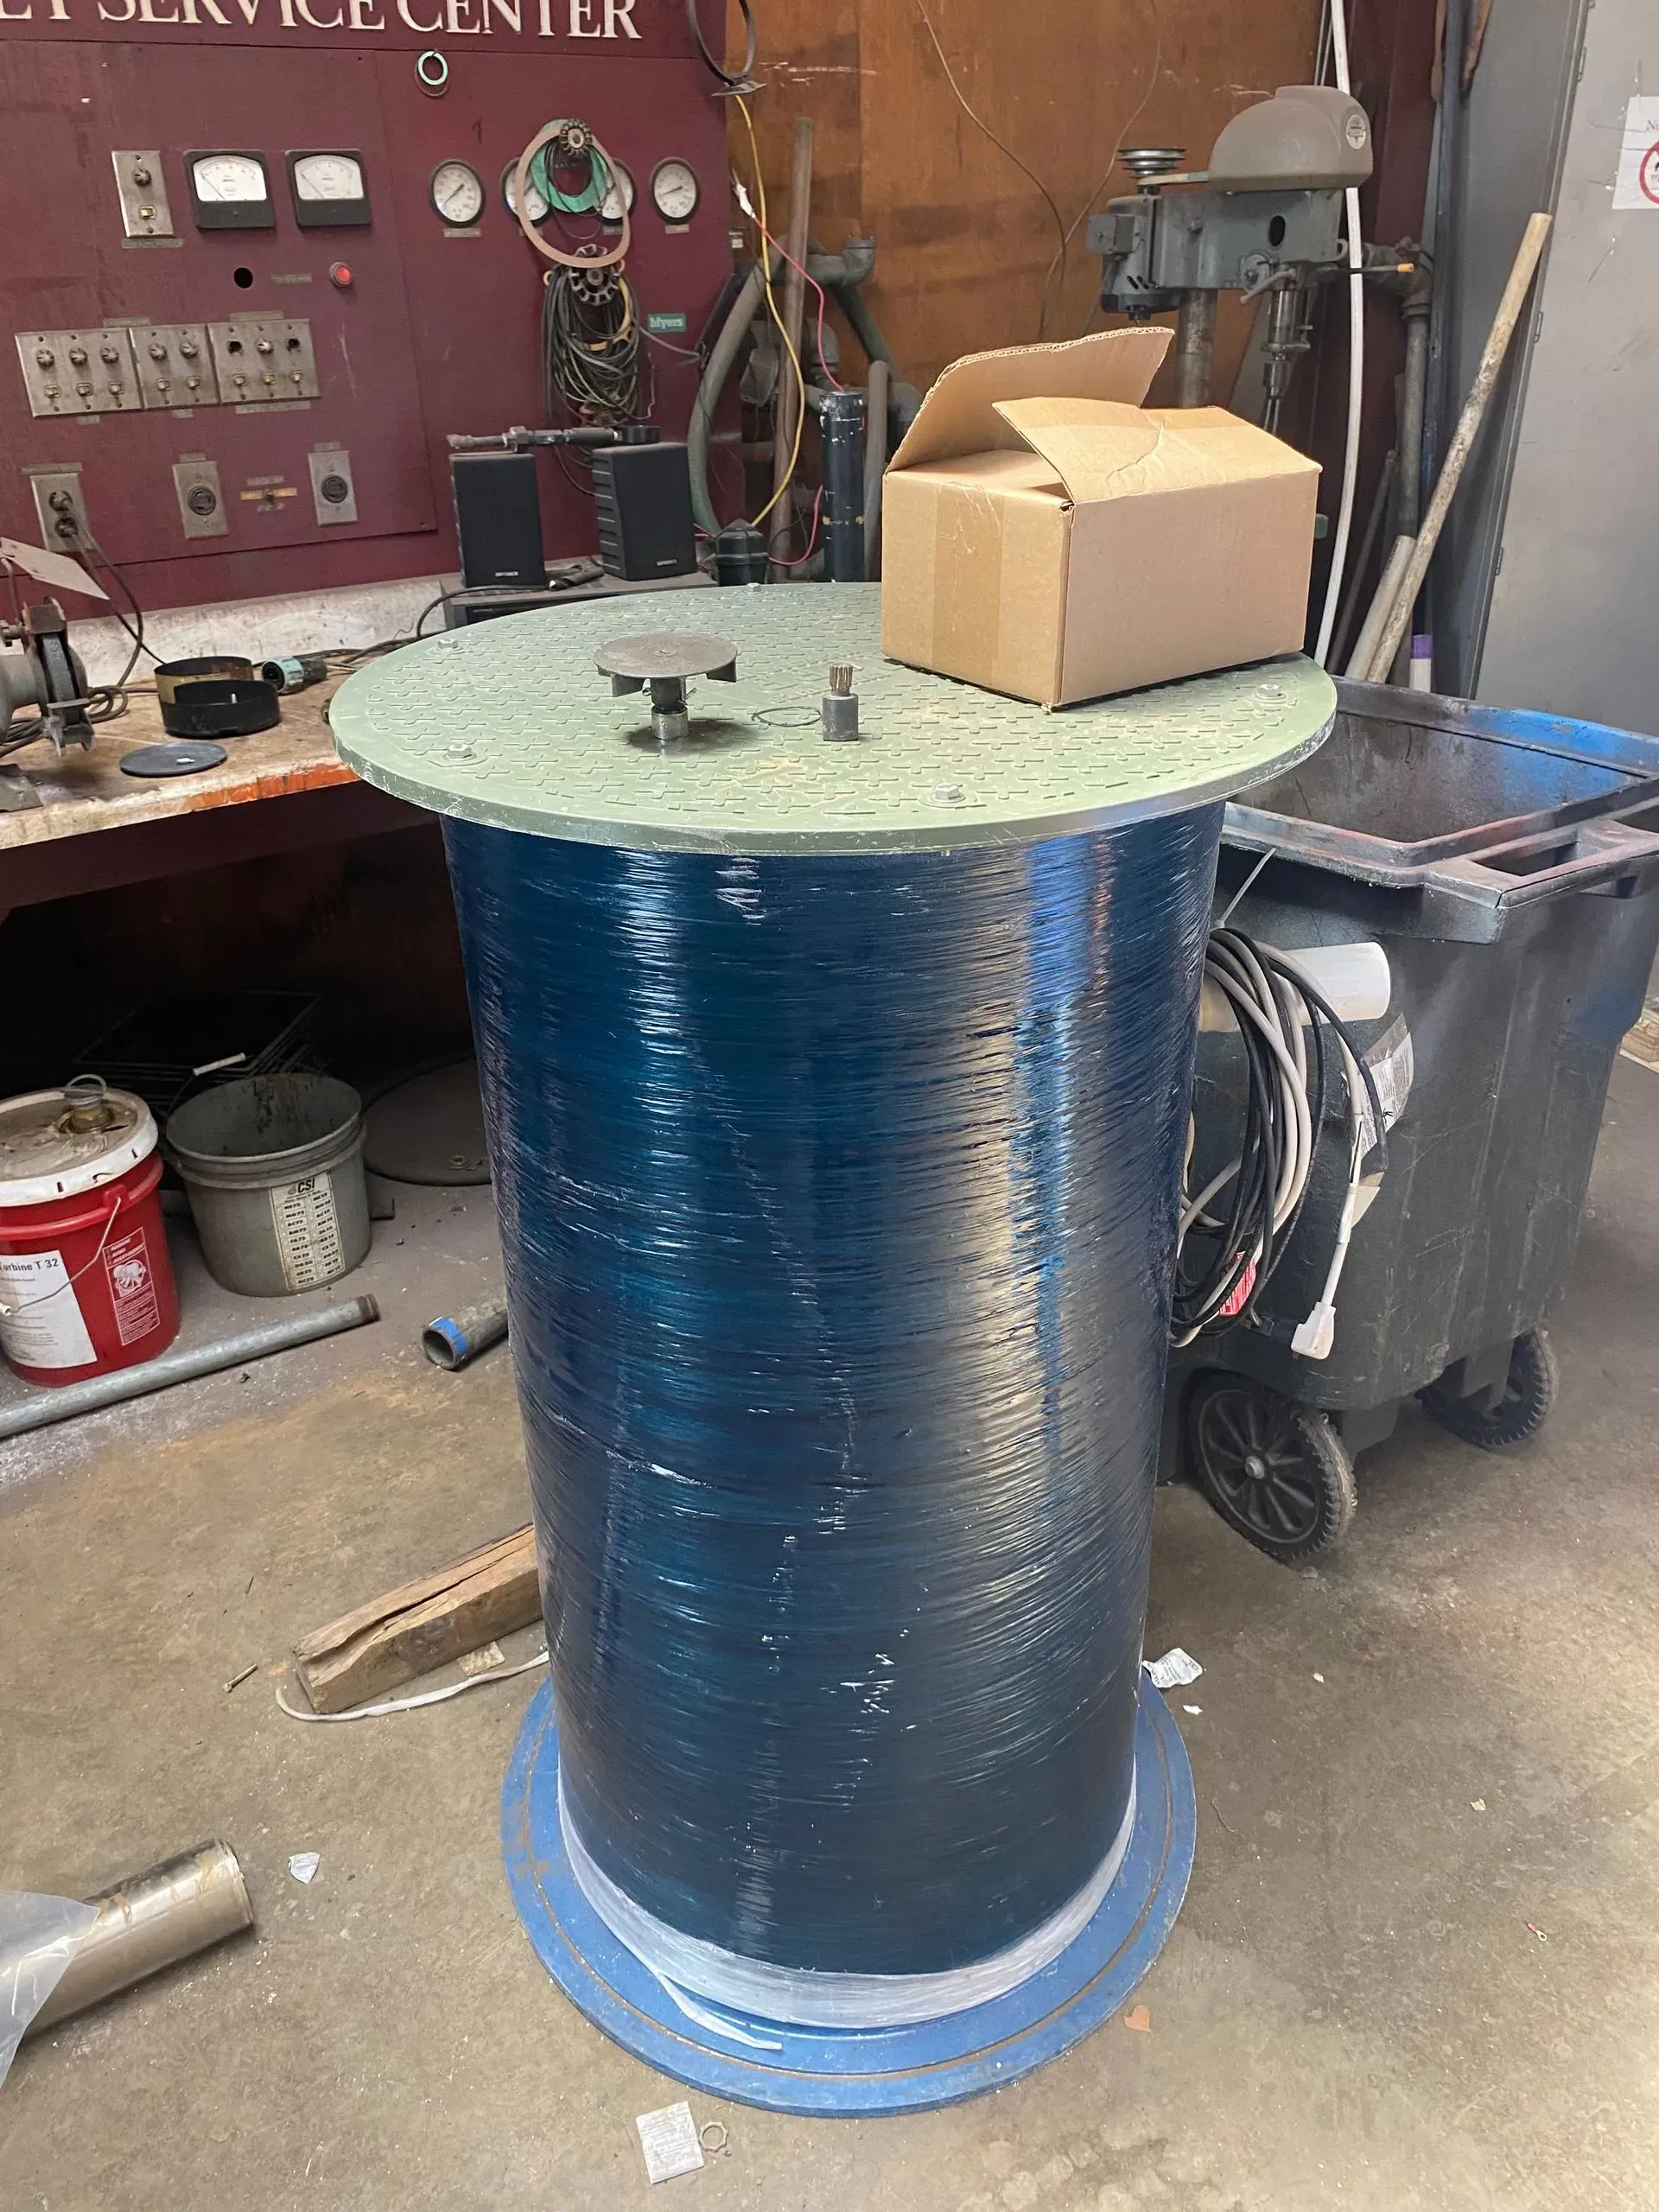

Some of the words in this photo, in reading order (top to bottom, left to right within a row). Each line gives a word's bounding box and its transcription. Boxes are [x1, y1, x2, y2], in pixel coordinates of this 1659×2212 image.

[396, 0, 642, 40] CENTER
[649, 317, 683, 329] Myers
[297, 1178, 315, 1193] CSI
[35, 1260, 41, 1269] T
[44, 1258, 60, 1268] 32
